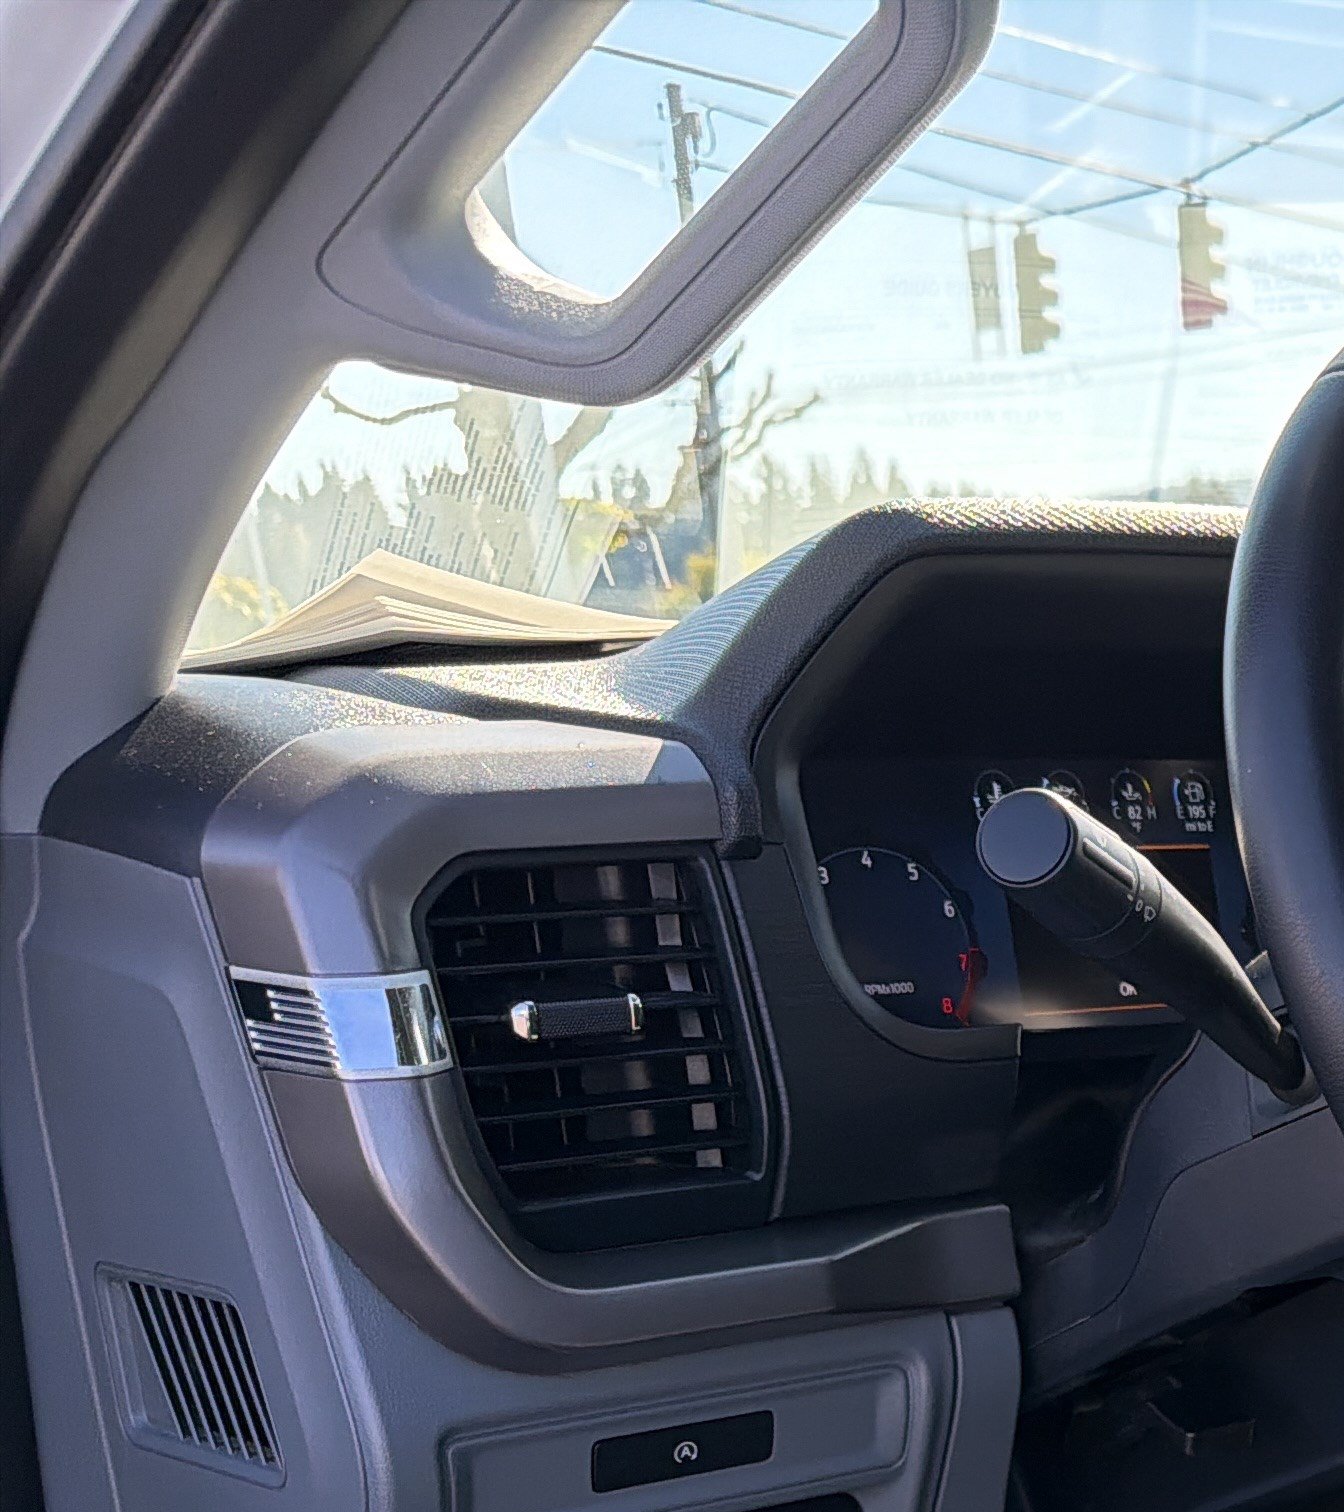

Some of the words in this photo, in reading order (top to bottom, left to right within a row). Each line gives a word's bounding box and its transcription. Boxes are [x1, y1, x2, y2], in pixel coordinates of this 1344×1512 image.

[1127, 807, 1143, 820] 82
[861, 850, 873, 869] 4
[817, 866, 830, 885] 3
[906, 862, 919, 881] 5
[943, 899, 956, 918] 6
[957, 952, 969, 972] 7
[942, 997, 954, 1014] 8
